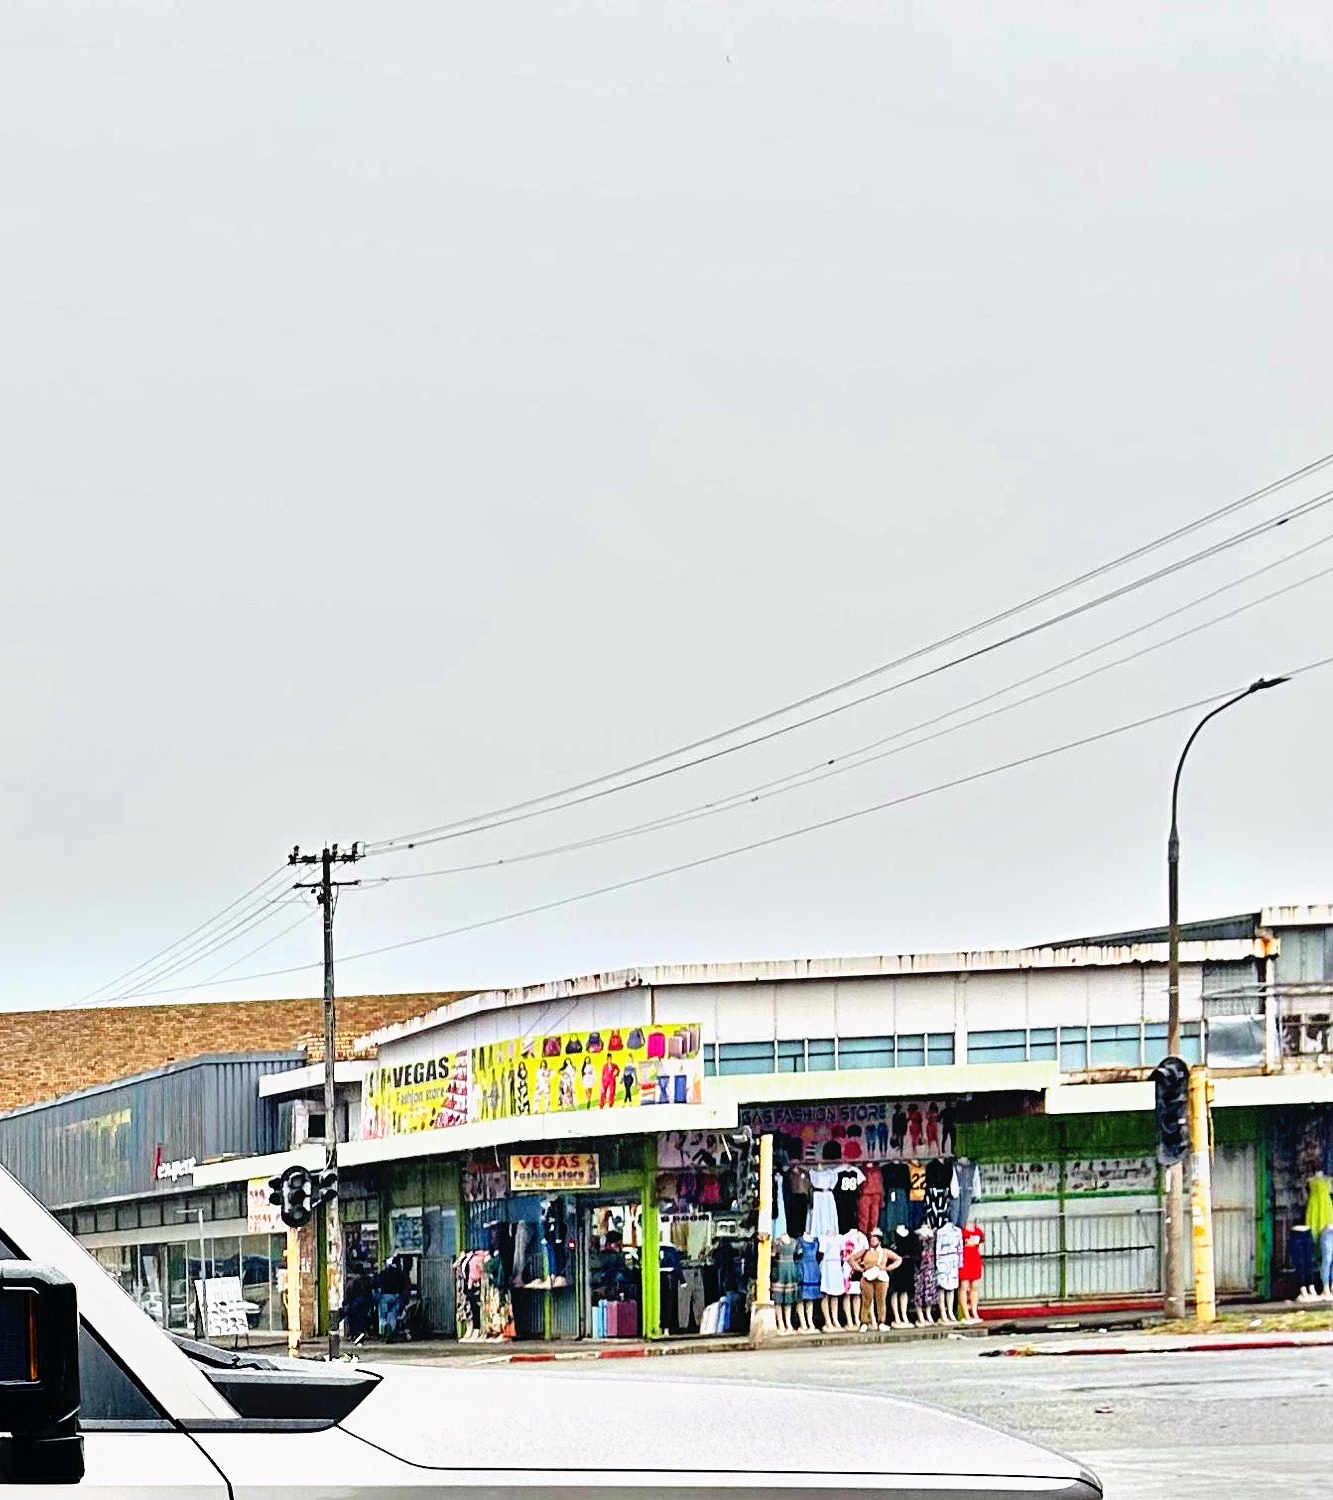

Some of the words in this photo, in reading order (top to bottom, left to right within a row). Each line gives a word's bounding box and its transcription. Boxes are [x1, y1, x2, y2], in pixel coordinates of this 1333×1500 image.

[393, 1056, 450, 1089] VEGAS
[775, 1104, 835, 1124] FASHION
[840, 1103, 887, 1121] STORE
[519, 1156, 580, 1169] VEGAS
[514, 1169, 554, 1179] Fashion
[558, 1169, 584, 1179] store
